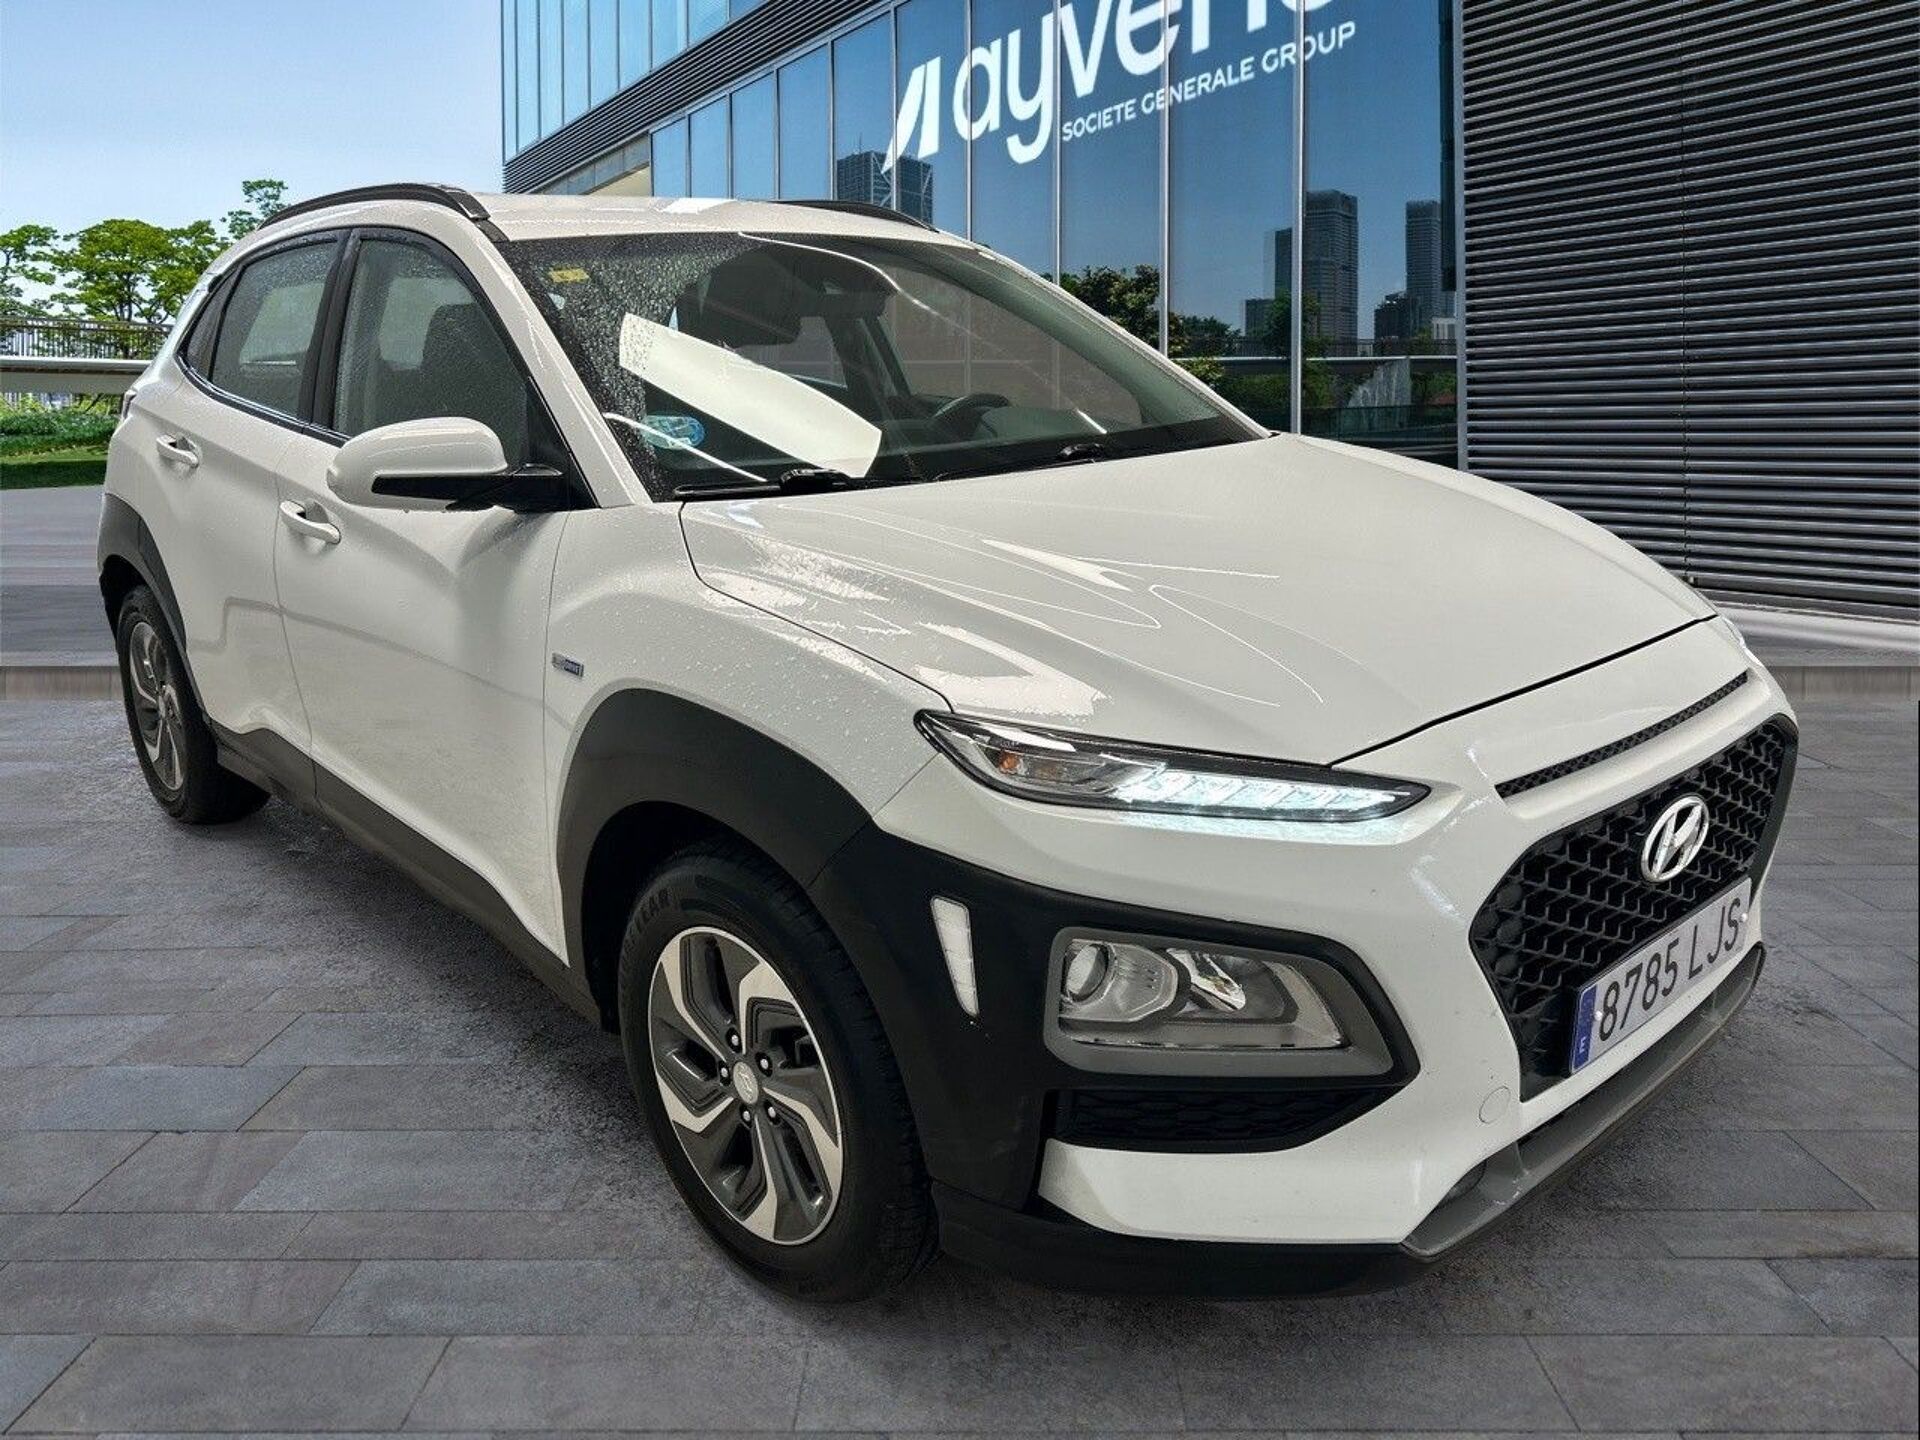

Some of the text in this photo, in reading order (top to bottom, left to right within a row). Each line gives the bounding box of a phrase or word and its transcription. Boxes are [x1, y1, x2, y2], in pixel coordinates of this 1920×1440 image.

[952, 0, 1333, 164] ayve
[1062, 21, 1356, 142] SOCIETE GENERALE GROUP
[1599, 897, 1741, 1041] 8785 LJS
[1579, 1036, 1587, 1054] E
